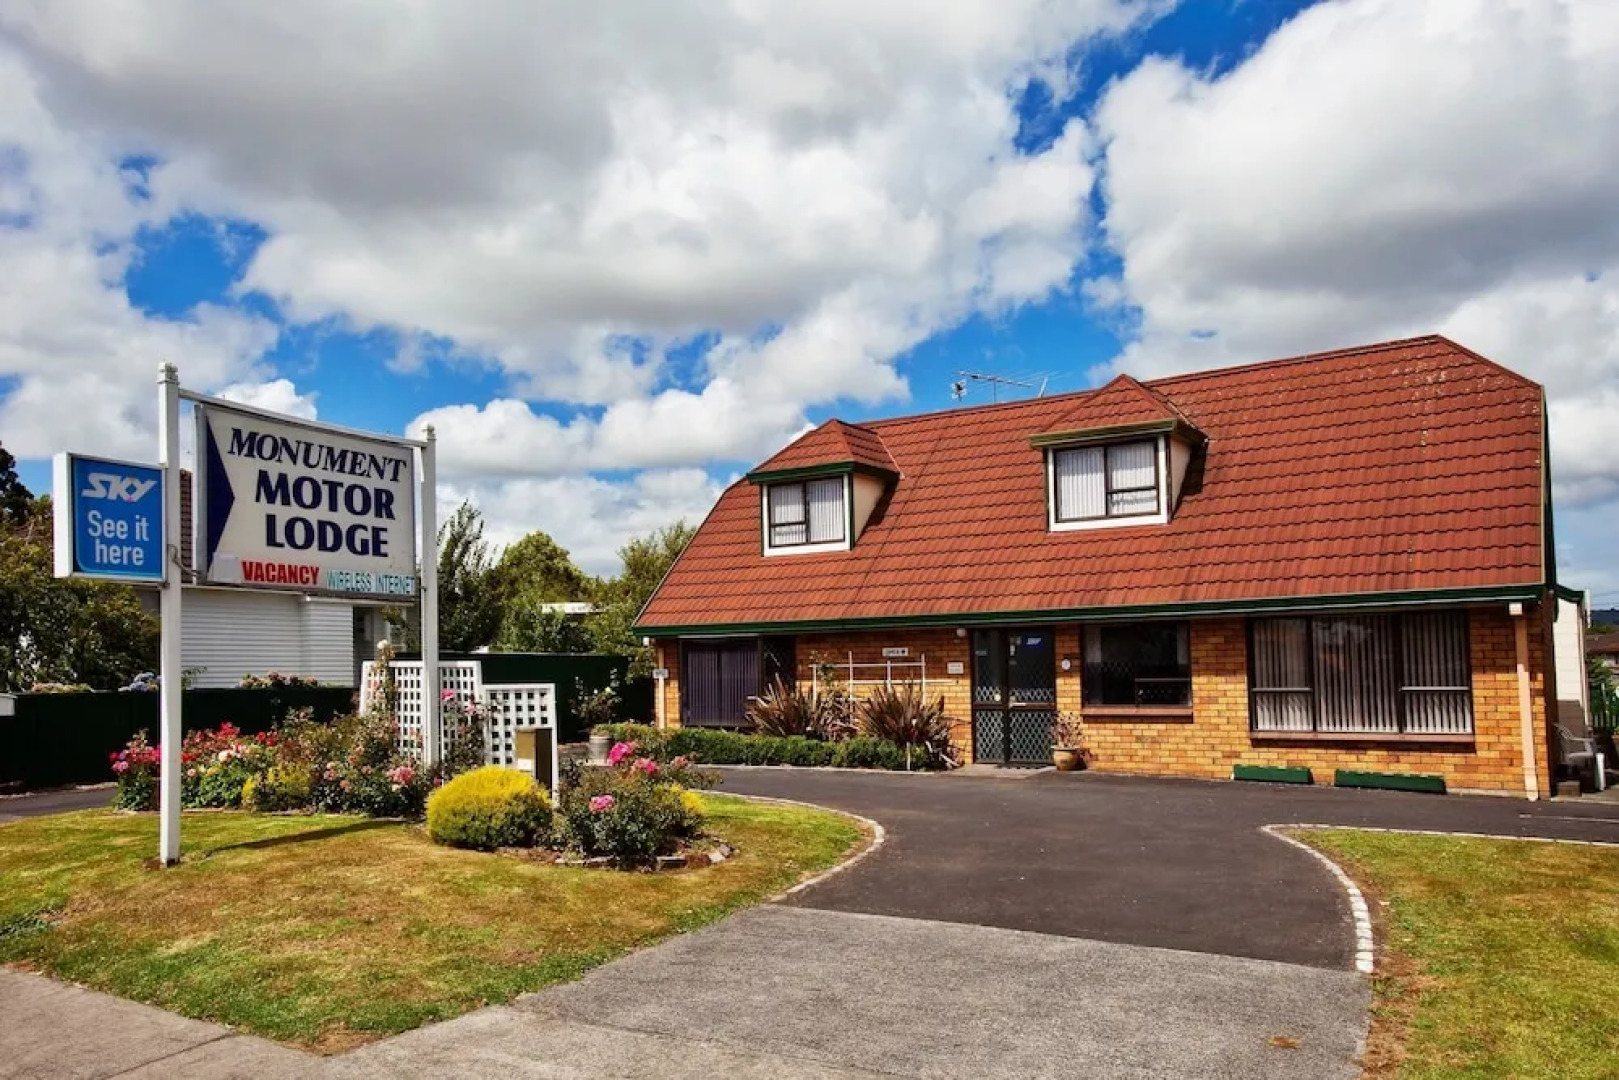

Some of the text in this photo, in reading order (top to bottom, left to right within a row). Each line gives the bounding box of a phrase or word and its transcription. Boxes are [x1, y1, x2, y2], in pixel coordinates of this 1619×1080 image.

[228, 427, 407, 482] MONUMENT
[81, 472, 158, 502] SKY
[255, 469, 395, 520] MOTOR
[88, 509, 149, 541] See it
[266, 514, 388, 558] LODGE
[95, 538, 144, 566] here
[241, 560, 414, 594] VACANCY WIRELESS INTERNET
